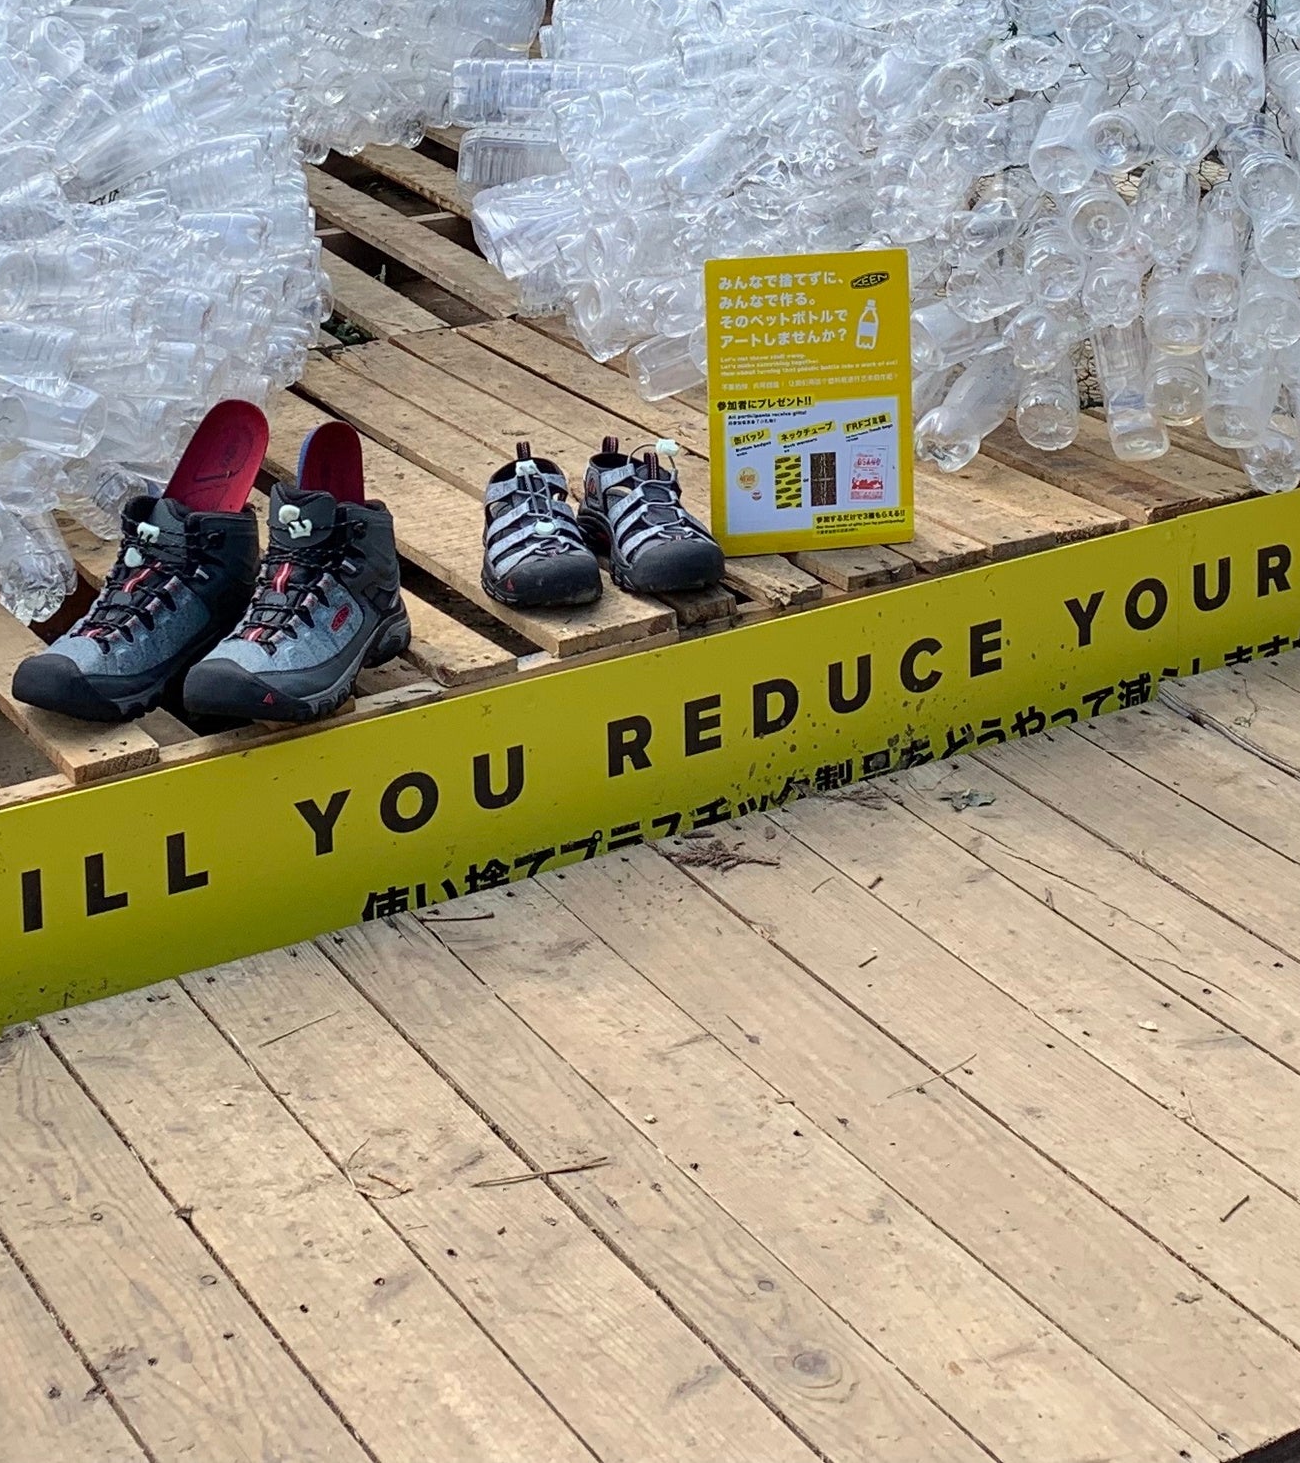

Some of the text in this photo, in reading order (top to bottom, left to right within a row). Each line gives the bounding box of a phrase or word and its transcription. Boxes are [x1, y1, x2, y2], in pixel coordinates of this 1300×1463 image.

[718, 272, 843, 290] みんなで捨てずに、
[852, 272, 888, 288] KEEN
[719, 293, 816, 309] みんなで作る。
[781, 421, 833, 442] ネックチューブ
[294, 744, 525, 856] YOU
[607, 618, 1002, 777] REDUCE
[1064, 544, 1292, 647] YOUR
